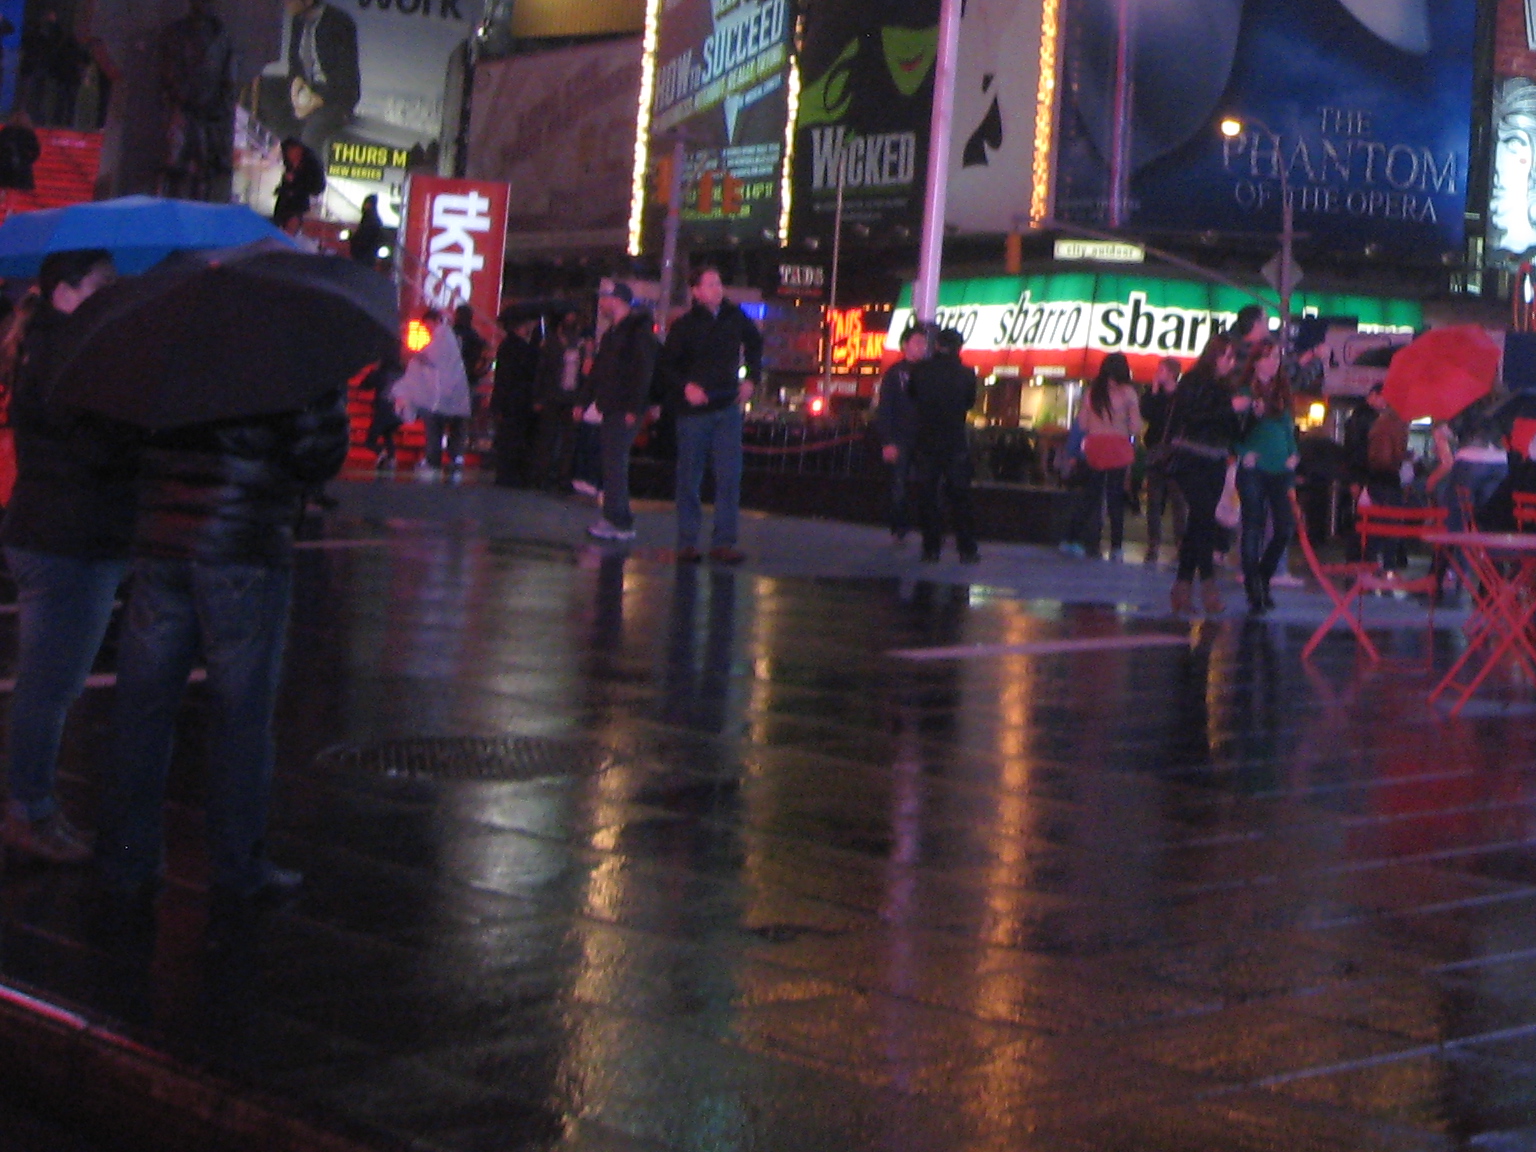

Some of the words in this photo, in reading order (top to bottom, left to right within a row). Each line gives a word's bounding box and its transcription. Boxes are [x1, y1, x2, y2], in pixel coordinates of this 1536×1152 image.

[1317, 105, 1373, 136] THE
[332, 142, 388, 166] THURS
[1222, 132, 1458, 195] PHANTOM
[1235, 180, 1272, 210] OF
[1286, 184, 1343, 214] THE
[1346, 190, 1438, 225] OPERA
[423, 191, 491, 311] tkts
[994, 289, 1082, 347] sbarro
